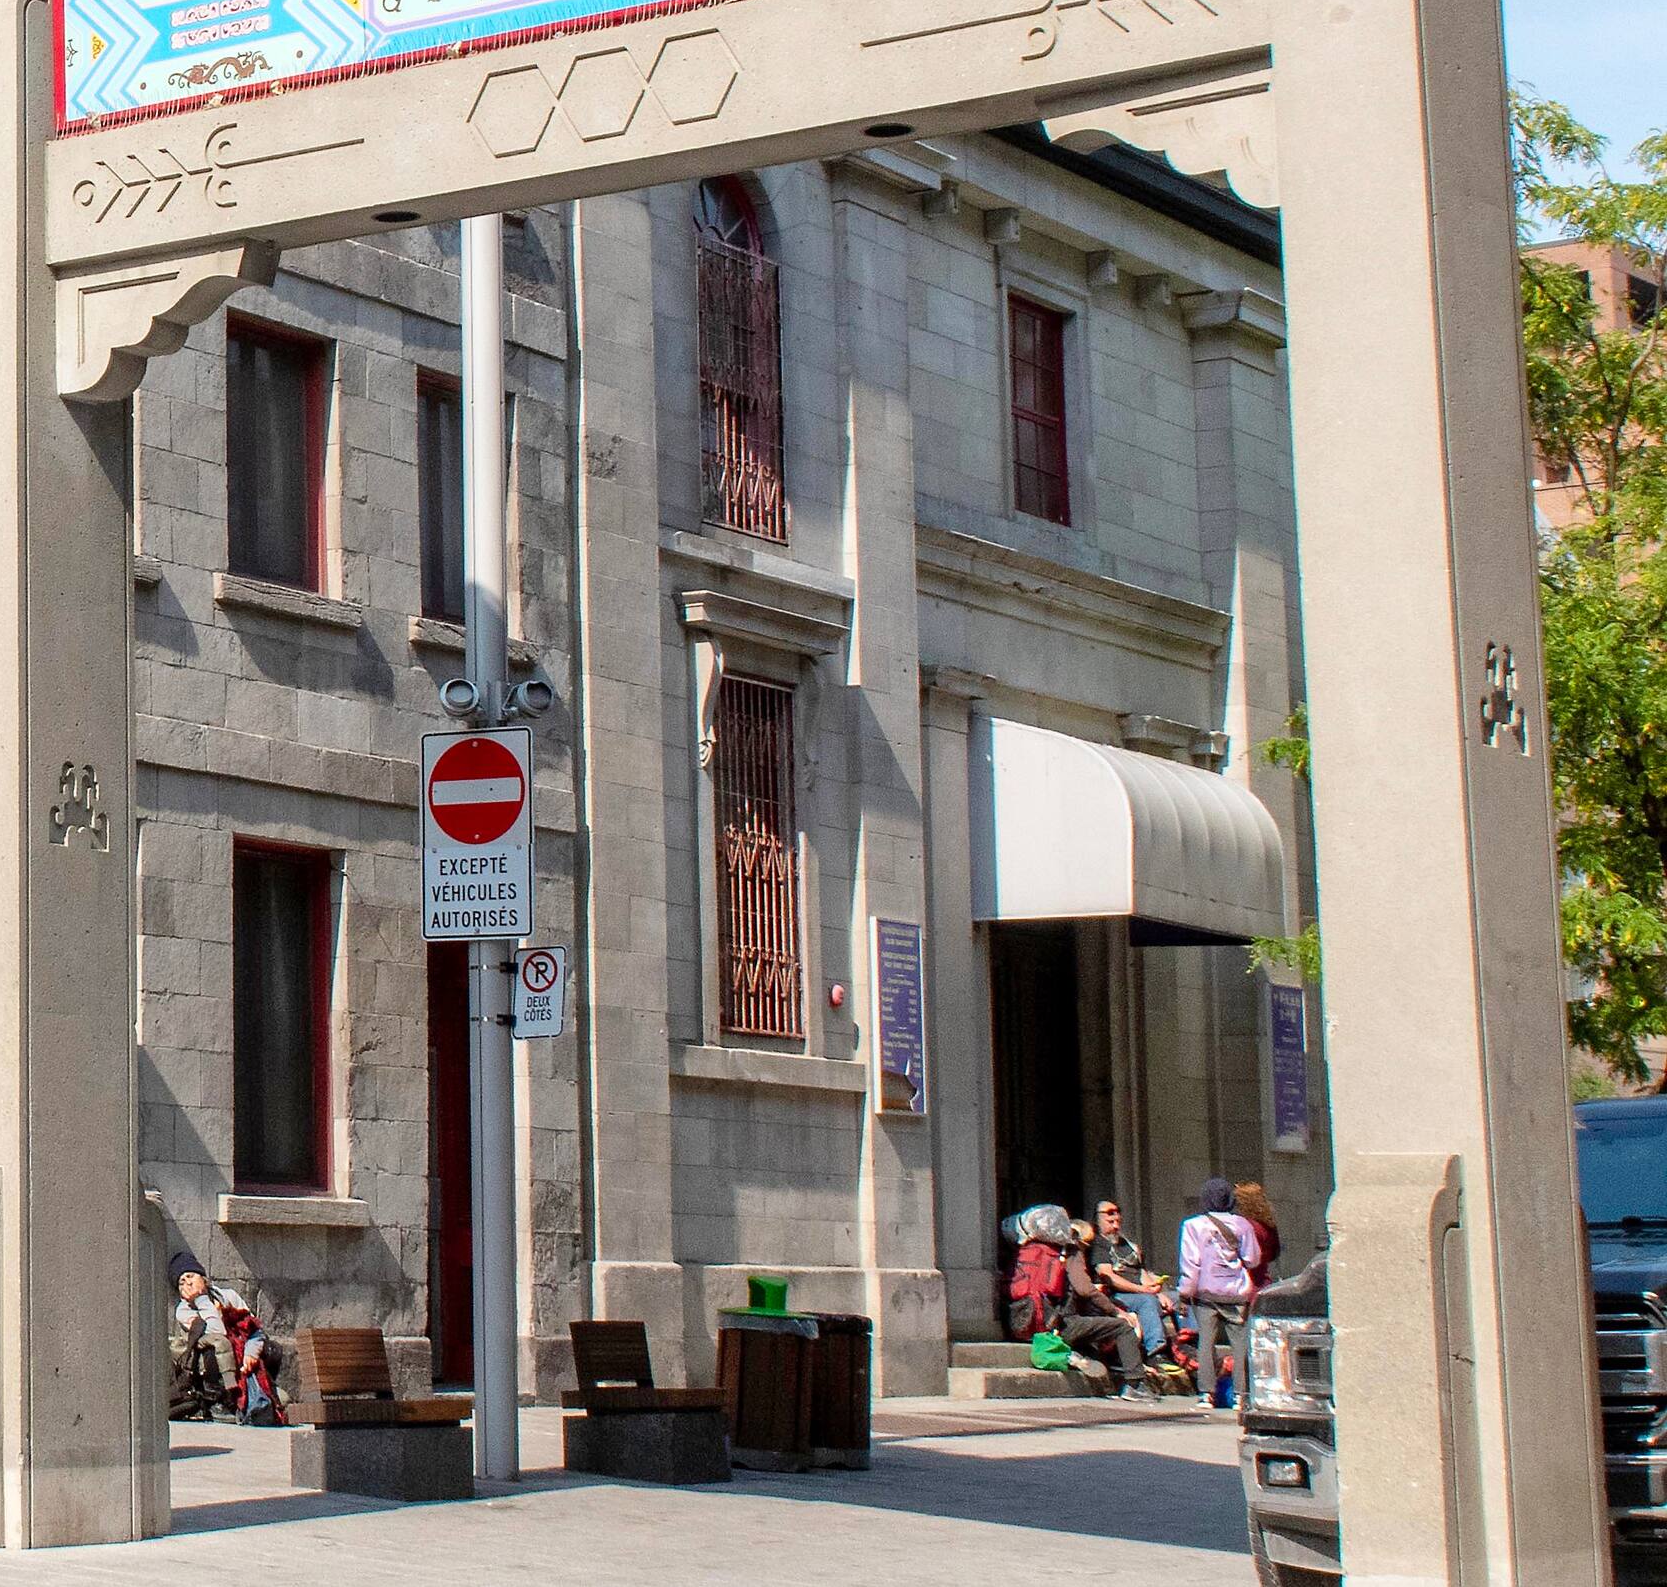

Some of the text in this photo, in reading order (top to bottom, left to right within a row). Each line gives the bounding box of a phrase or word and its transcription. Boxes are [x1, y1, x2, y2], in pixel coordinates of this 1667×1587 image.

[439, 852, 508, 876] EXCEPTÉ
[431, 881, 517, 903] VÉHICULES
[431, 905, 518, 929] AUTORISÉS
[526, 995, 551, 1008] DEUX
[523, 1007, 553, 1022] CÔTÉS
